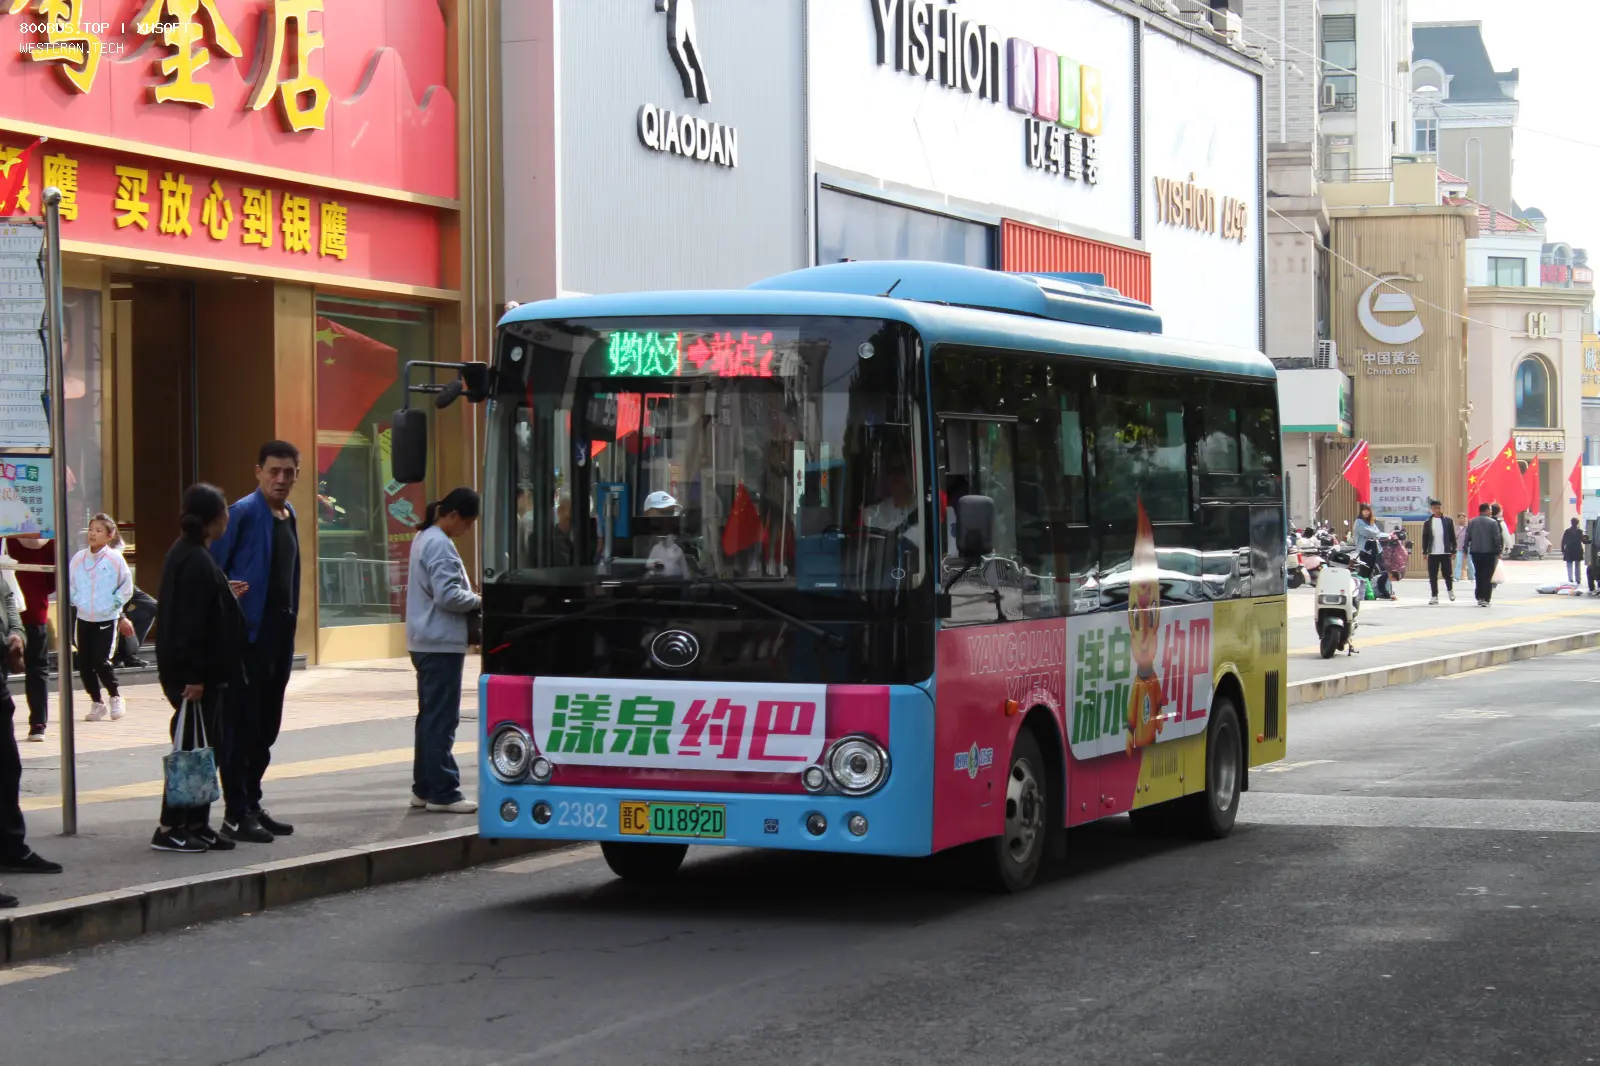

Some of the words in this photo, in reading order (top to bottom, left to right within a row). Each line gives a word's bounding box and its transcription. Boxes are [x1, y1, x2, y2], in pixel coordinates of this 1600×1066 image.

[637, 103, 738, 168] QIAODAN
[114, 165, 349, 261] 买放心到银鹰
[1362, 351, 1420, 365] 中国黄金
[1367, 367, 1392, 375] China
[1395, 367, 1416, 375] Gold
[968, 628, 1065, 675] YANGQUAN
[545, 693, 816, 762] 漾泉约巴
[558, 801, 608, 829] 2382
[653, 807, 724, 834] 01892D
